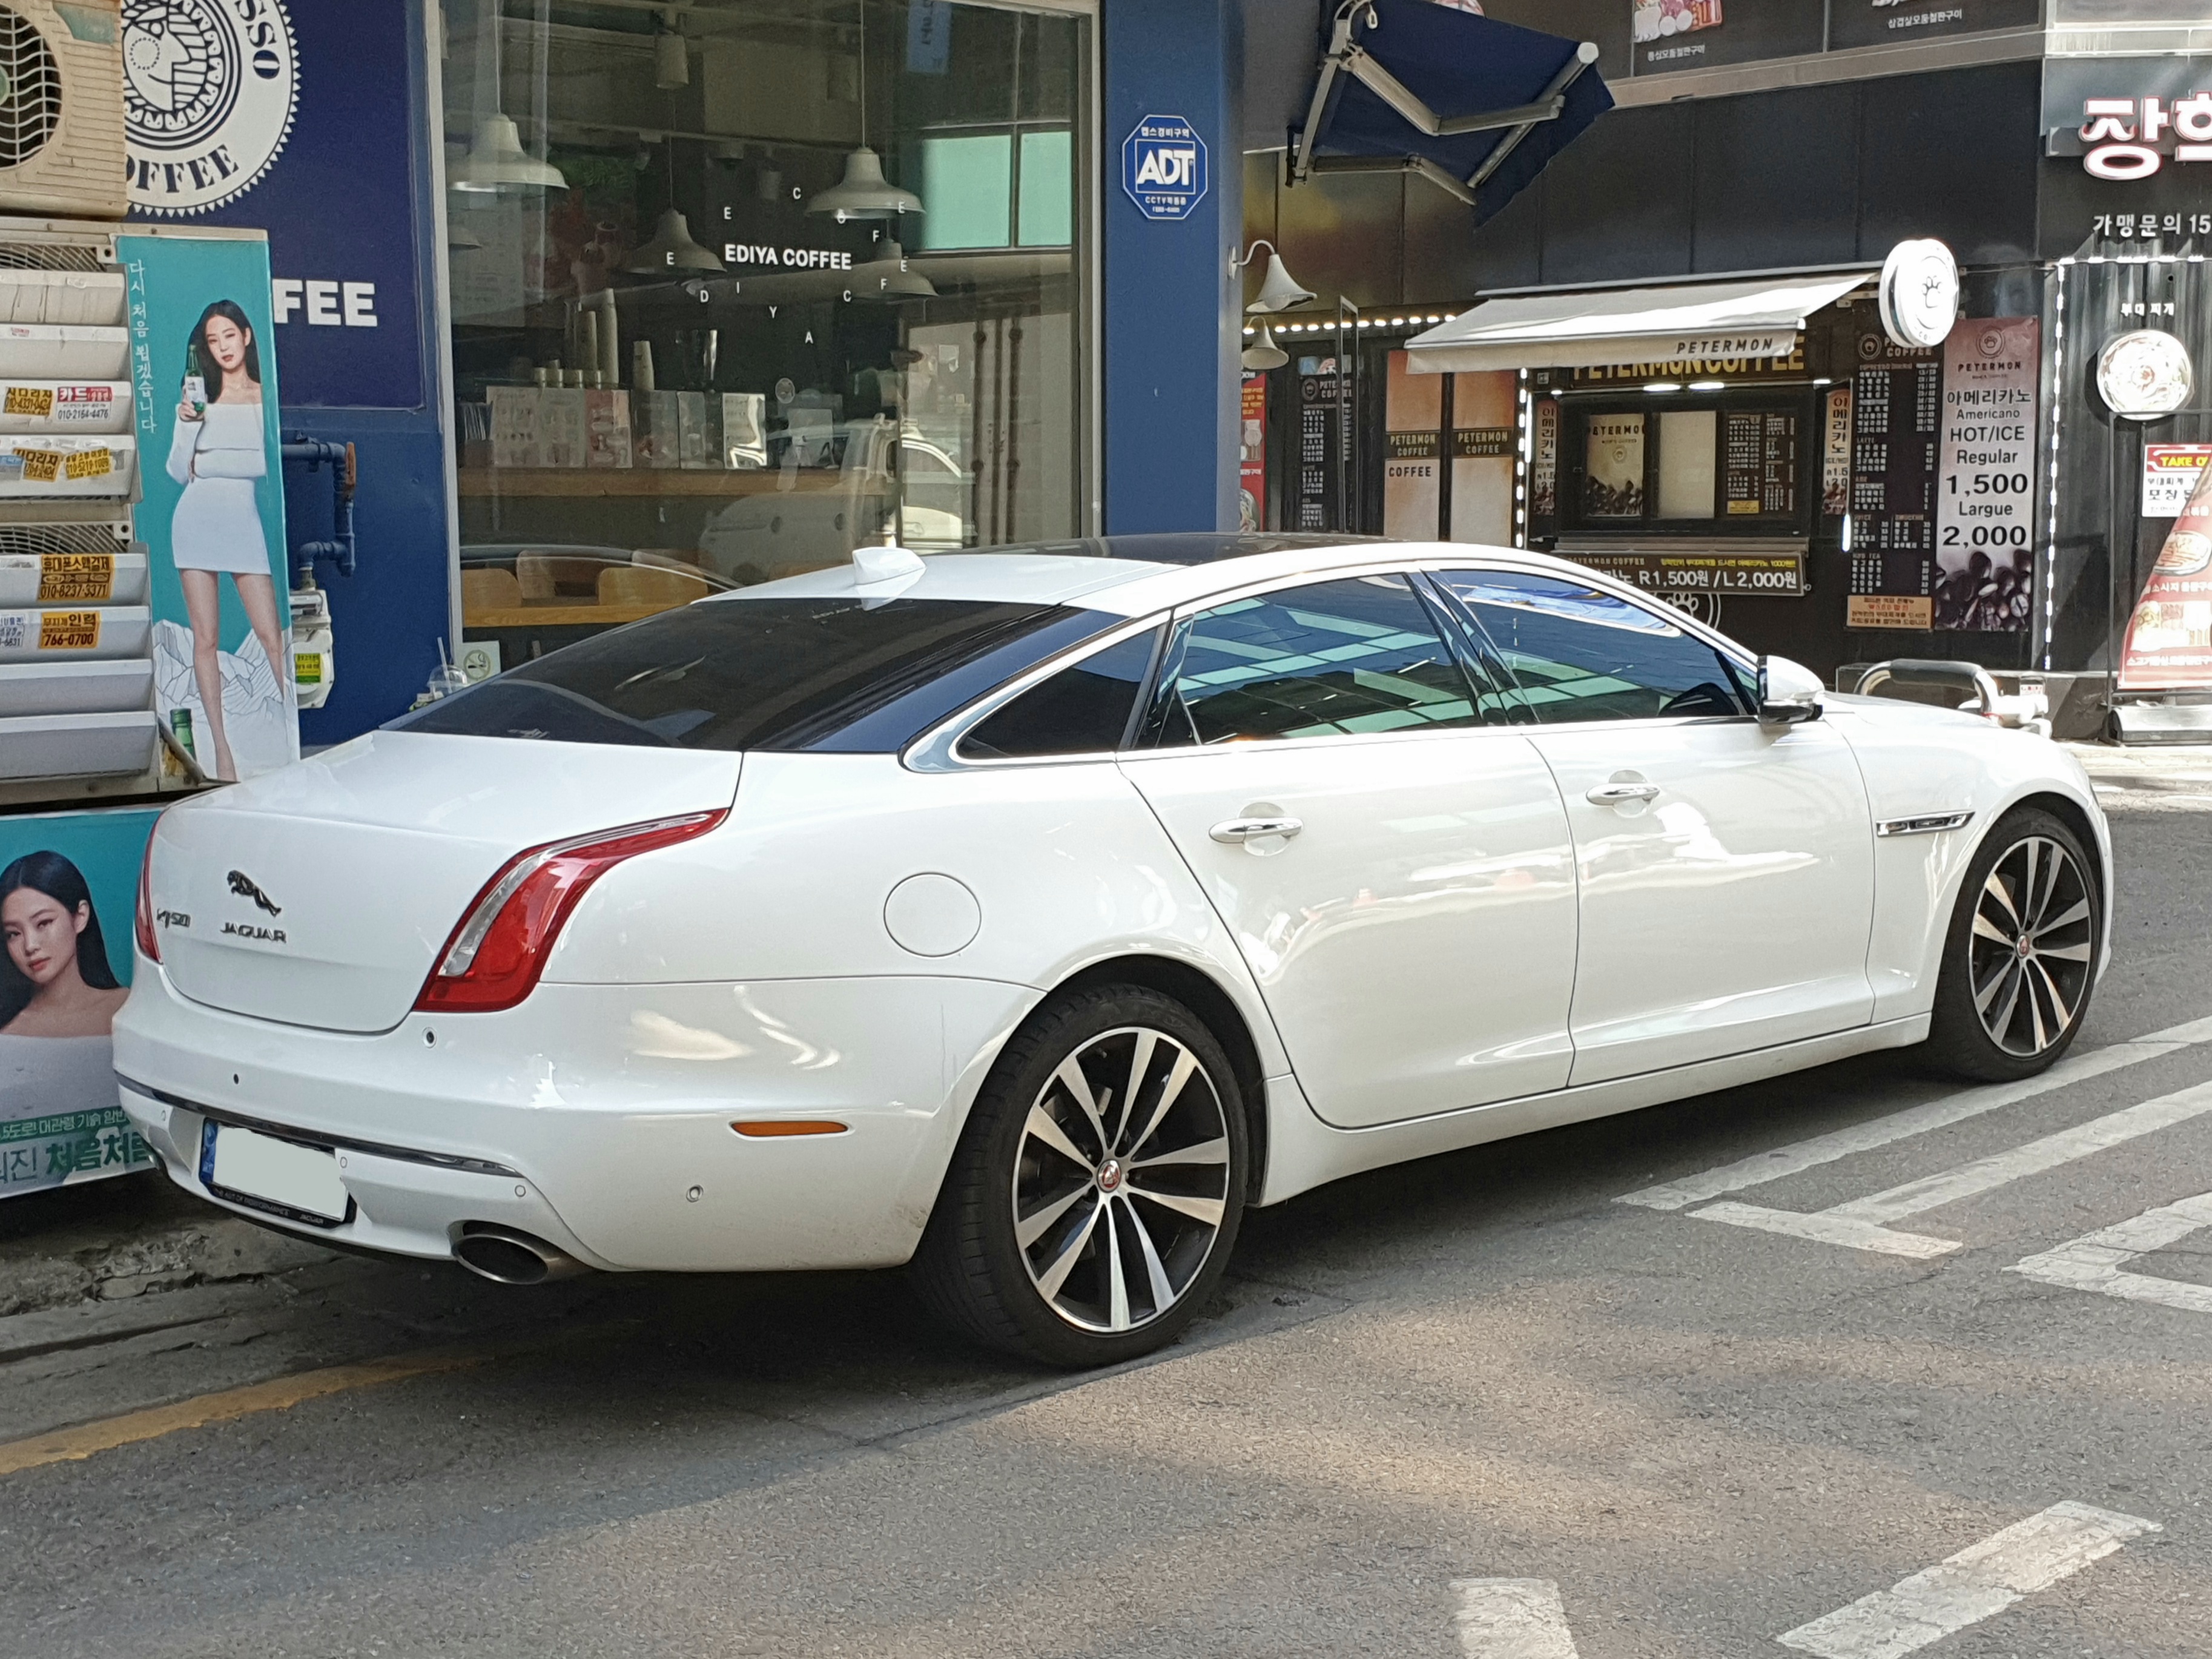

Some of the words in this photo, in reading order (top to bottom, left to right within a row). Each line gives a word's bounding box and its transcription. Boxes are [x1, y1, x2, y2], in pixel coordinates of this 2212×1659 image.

[1137, 149, 1195, 186] ADT
[2093, 213, 2181, 237] 가맹문의
[725, 244, 779, 265] EDIYA
[783, 248, 852, 271] COFFEE
[130, 259, 145, 296] 다시
[133, 302, 149, 338] 처음
[1676, 338, 1773, 354] PETERMON
[1886, 347, 1932, 357] COFFEE
[1958, 361, 2021, 372] PETERMON
[1947, 388, 2032, 406] 아메리카노
[1956, 408, 2020, 420] Americano
[1390, 434, 1436, 446] PETERMON
[1457, 431, 1508, 443] PETERMON
[1950, 425, 2025, 442] HOT/ICE
[1397, 447, 1428, 457] COFFEE
[1465, 444, 1499, 454] COFFEE
[1956, 449, 2018, 465] Regular
[2160, 456, 2193, 467] TAKE
[1388, 466, 1431, 477] COFFEE
[1946, 473, 2028, 496] 1,500
[1959, 502, 2013, 518] Largue
[1943, 526, 2027, 549] 2,000
[44, 633, 94, 647] 766-0700
[220, 922, 287, 944] JAGUAR
